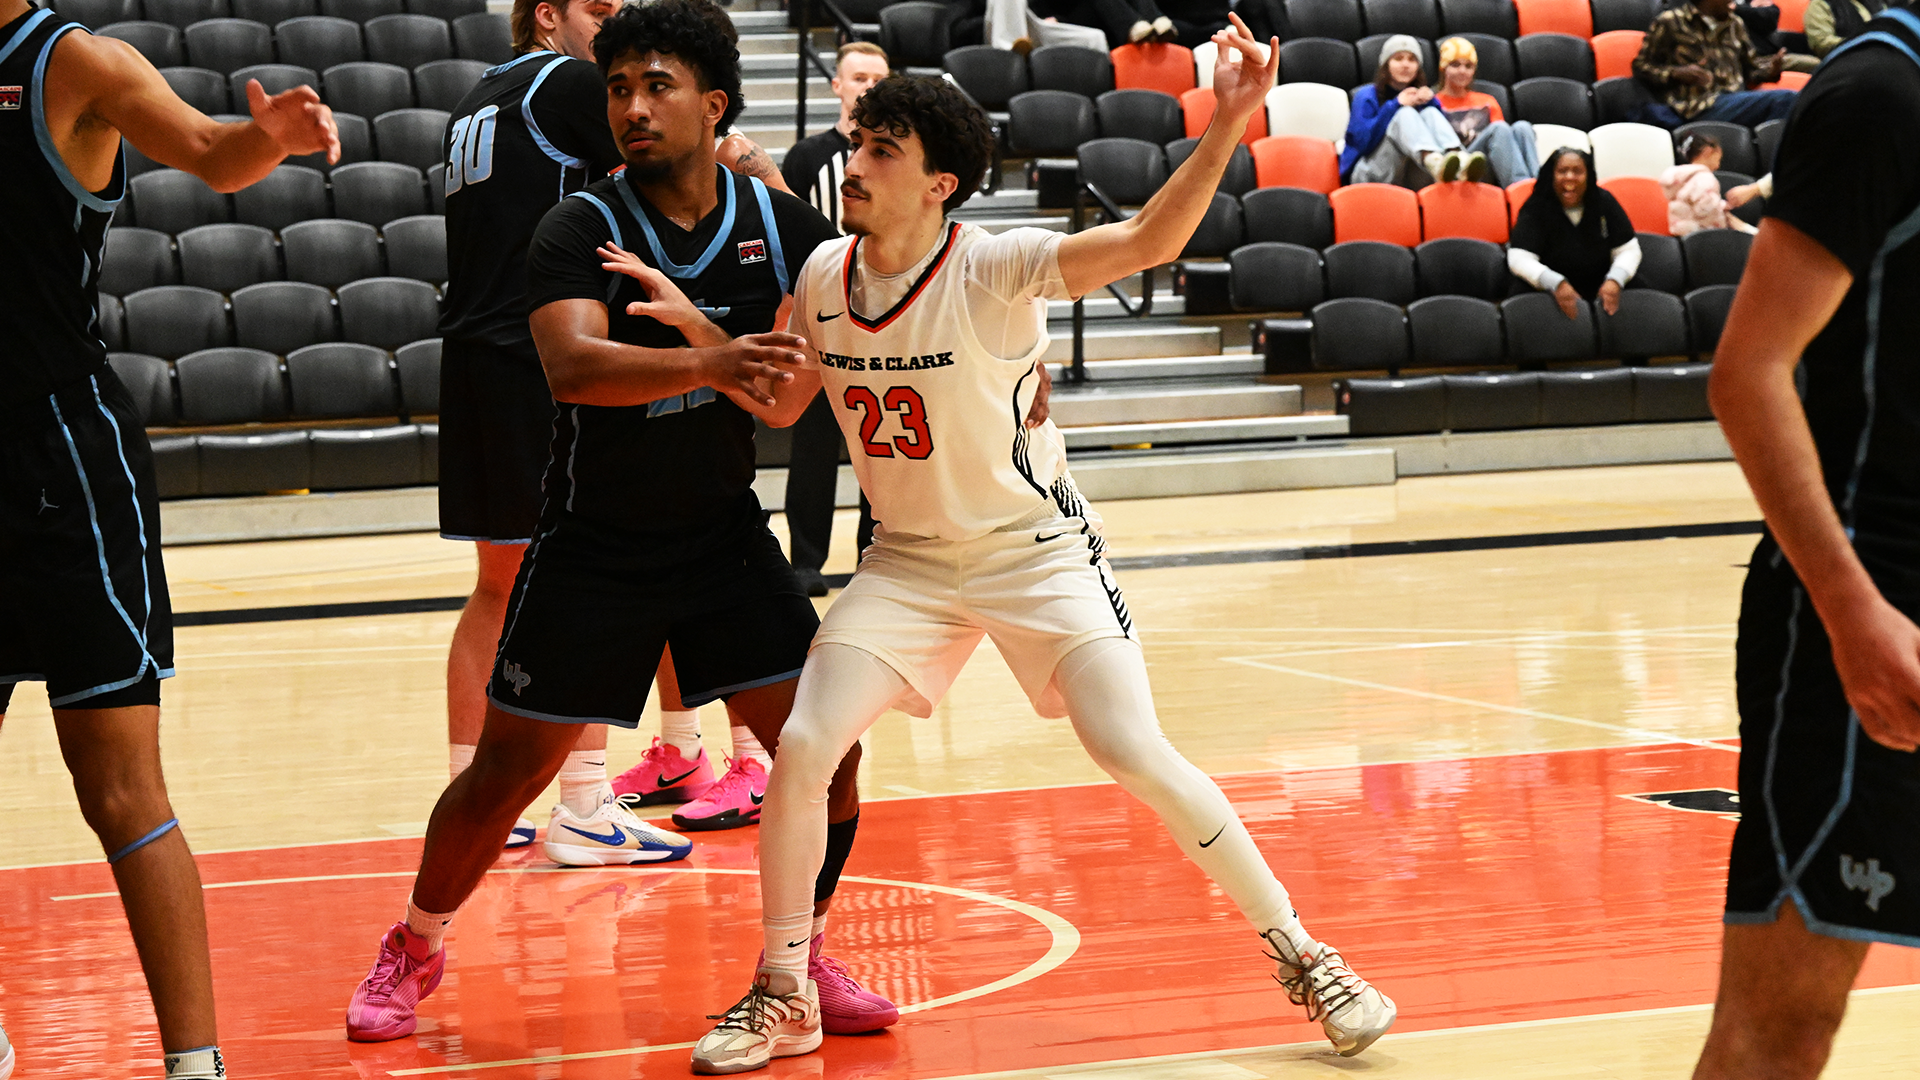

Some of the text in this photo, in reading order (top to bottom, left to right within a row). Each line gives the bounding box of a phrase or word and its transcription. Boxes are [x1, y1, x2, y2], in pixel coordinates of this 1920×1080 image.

[445, 104, 500, 198] 30
[740, 246, 764, 257] CCC
[818, 351, 954, 371] LEWIS & CLARK
[843, 385, 934, 460] 23
[503, 658, 531, 697] WP
[1839, 853, 1896, 912] WP
